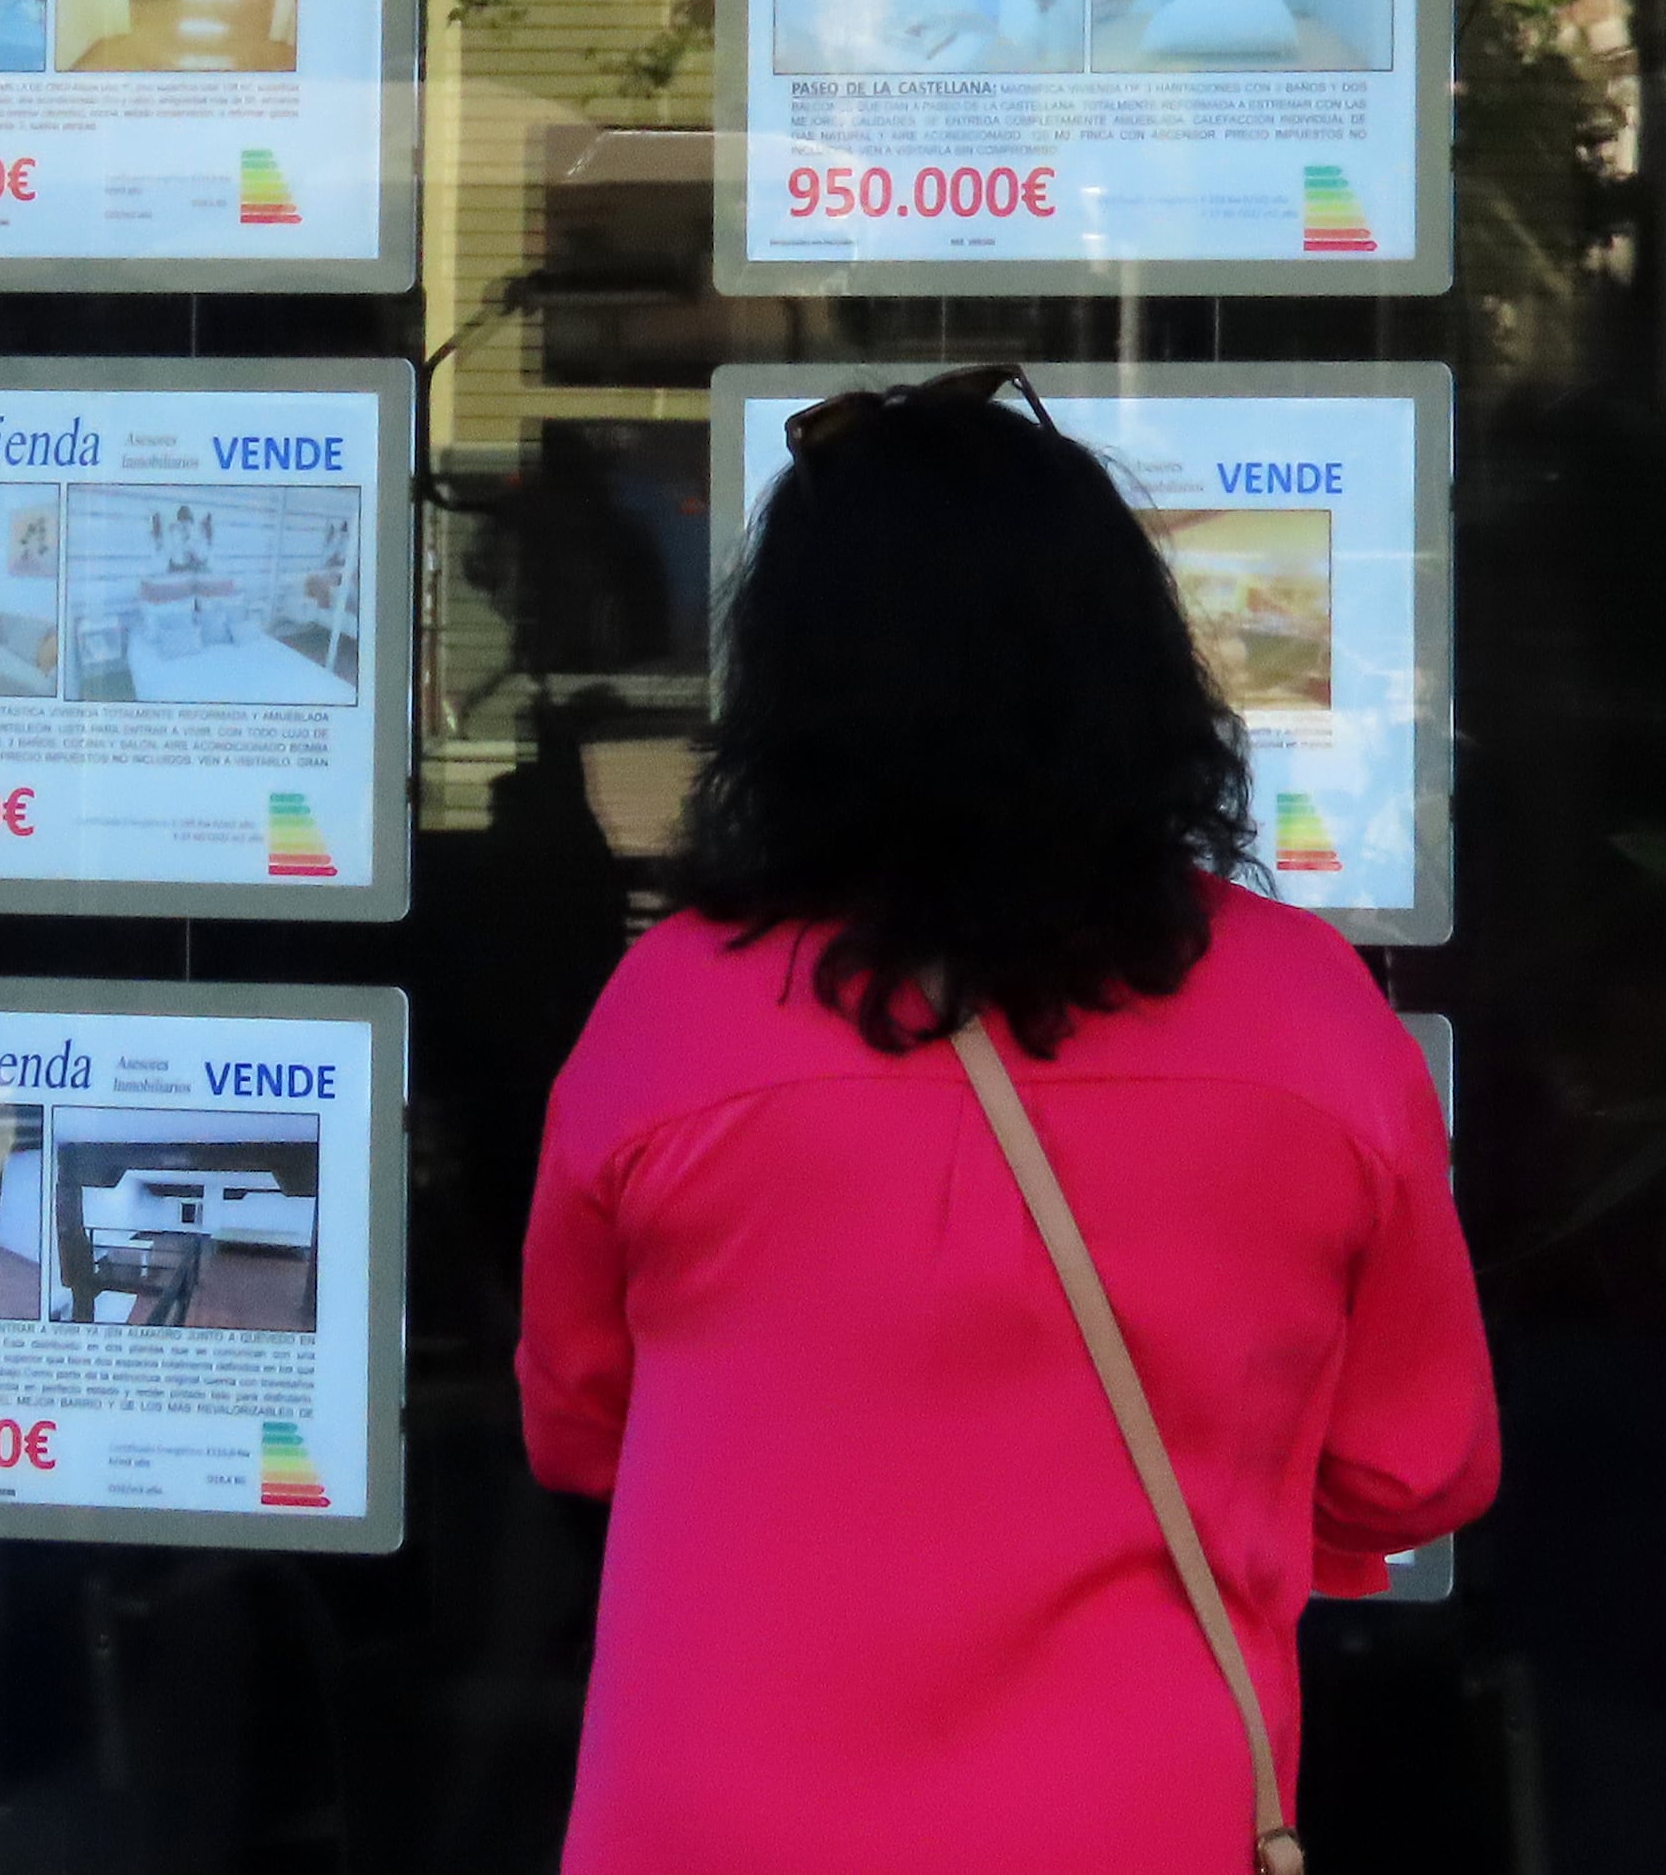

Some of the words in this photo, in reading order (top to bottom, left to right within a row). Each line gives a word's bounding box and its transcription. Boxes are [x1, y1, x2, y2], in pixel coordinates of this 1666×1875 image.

[792, 81, 839, 95] PASEO
[846, 81, 866, 94] DE
[873, 81, 892, 94] LA
[898, 81, 997, 95] CASTELLANA:
[787, 167, 1057, 219] 950.000€
[212, 435, 344, 471] VENDE
[1217, 461, 1344, 495] VENDE
[205, 1061, 337, 1100] VENDE
